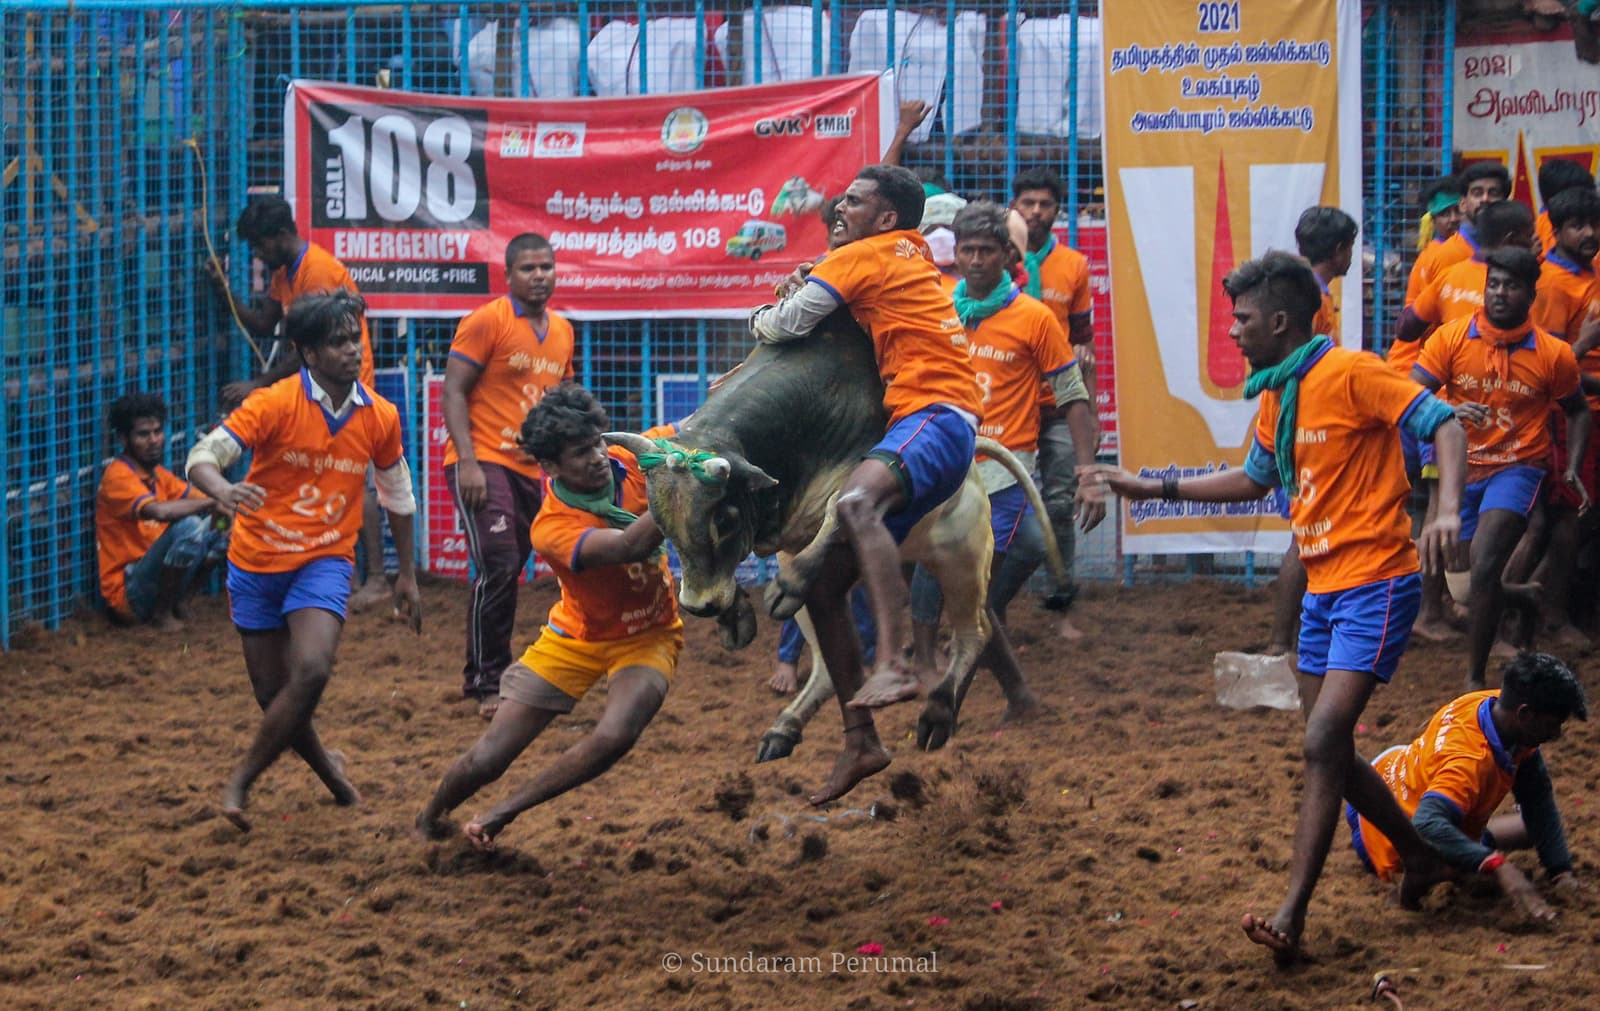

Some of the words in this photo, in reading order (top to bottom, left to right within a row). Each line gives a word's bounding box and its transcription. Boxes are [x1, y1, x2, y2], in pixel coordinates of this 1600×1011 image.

[1198, 2, 1239, 32] 2021
[1203, 43, 1242, 70] முதல்
[1245, 40, 1330, 66] ஜல்லிக்கட்டு
[1229, 106, 1314, 132] ஜல்லிக்கட்டு
[1466, 87, 1600, 127] அவனியாபுர
[755, 119, 804, 135] GVK
[816, 115, 851, 132] EMRI
[328, 114, 477, 223] 108
[326, 154, 342, 219] CALL
[649, 188, 764, 216] ஜல்லிக்கட்டு
[334, 230, 471, 260] EMERGENCY
[682, 227, 721, 248] 108
[349, 267, 386, 283] DICAL
[396, 267, 439, 283] POLICE
[450, 268, 477, 284] FIRE
